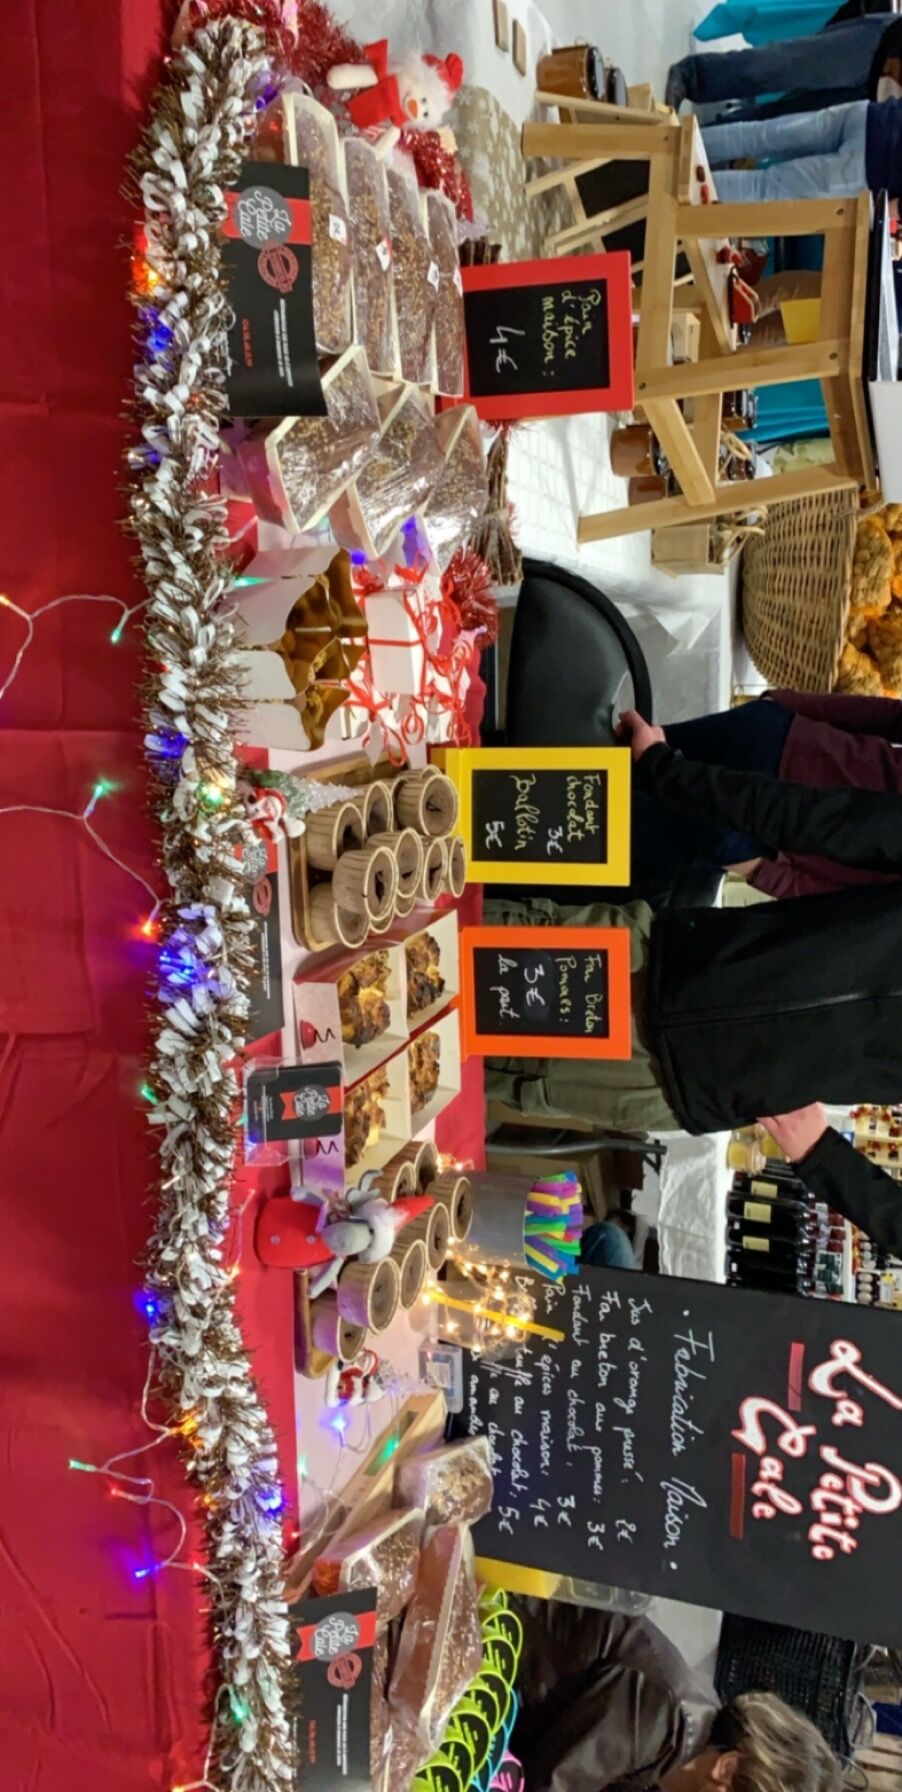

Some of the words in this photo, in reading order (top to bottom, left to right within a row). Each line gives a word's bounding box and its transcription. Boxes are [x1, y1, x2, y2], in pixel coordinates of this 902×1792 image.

[237, 198, 256, 237] Cale
[254, 190, 274, 241] Petite
[268, 208, 293, 233] La
[576, 288, 602, 336] Pain
[509, 773, 541, 851] Ballotin
[566, 775, 585, 842] chocolat
[583, 774, 601, 836] Fondant
[485, 820, 505, 850] 5€
[546, 825, 563, 856] 3€
[498, 954, 518, 976] la
[584, 953, 602, 983] Far
[584, 992, 603, 1034] Breton
[542, 1283, 566, 1315] Pain
[571, 1284, 591, 1347] Fondant
[628, 1298, 652, 1326] Jus
[570, 1359, 582, 1378] au
[597, 1332, 618, 1388] breton
[488, 1387, 500, 1406] au
[670, 1329, 715, 1456] Fabrication
[808, 1340, 902, 1427] La
[514, 1396, 525, 1414] au
[731, 1397, 817, 1520] Cale
[529, 1498, 552, 1528] 4€
[557, 1495, 576, 1527] 3€
[660, 1476, 708, 1549] Maison
[808, 1445, 902, 1561] Petite
[498, 1506, 520, 1536] 5€
[587, 1521, 605, 1551] 3€
[614, 1519, 637, 1544] 2€
[314, 1623, 331, 1657] Cale
[328, 1616, 345, 1656] Petite
[339, 1624, 359, 1646] La
